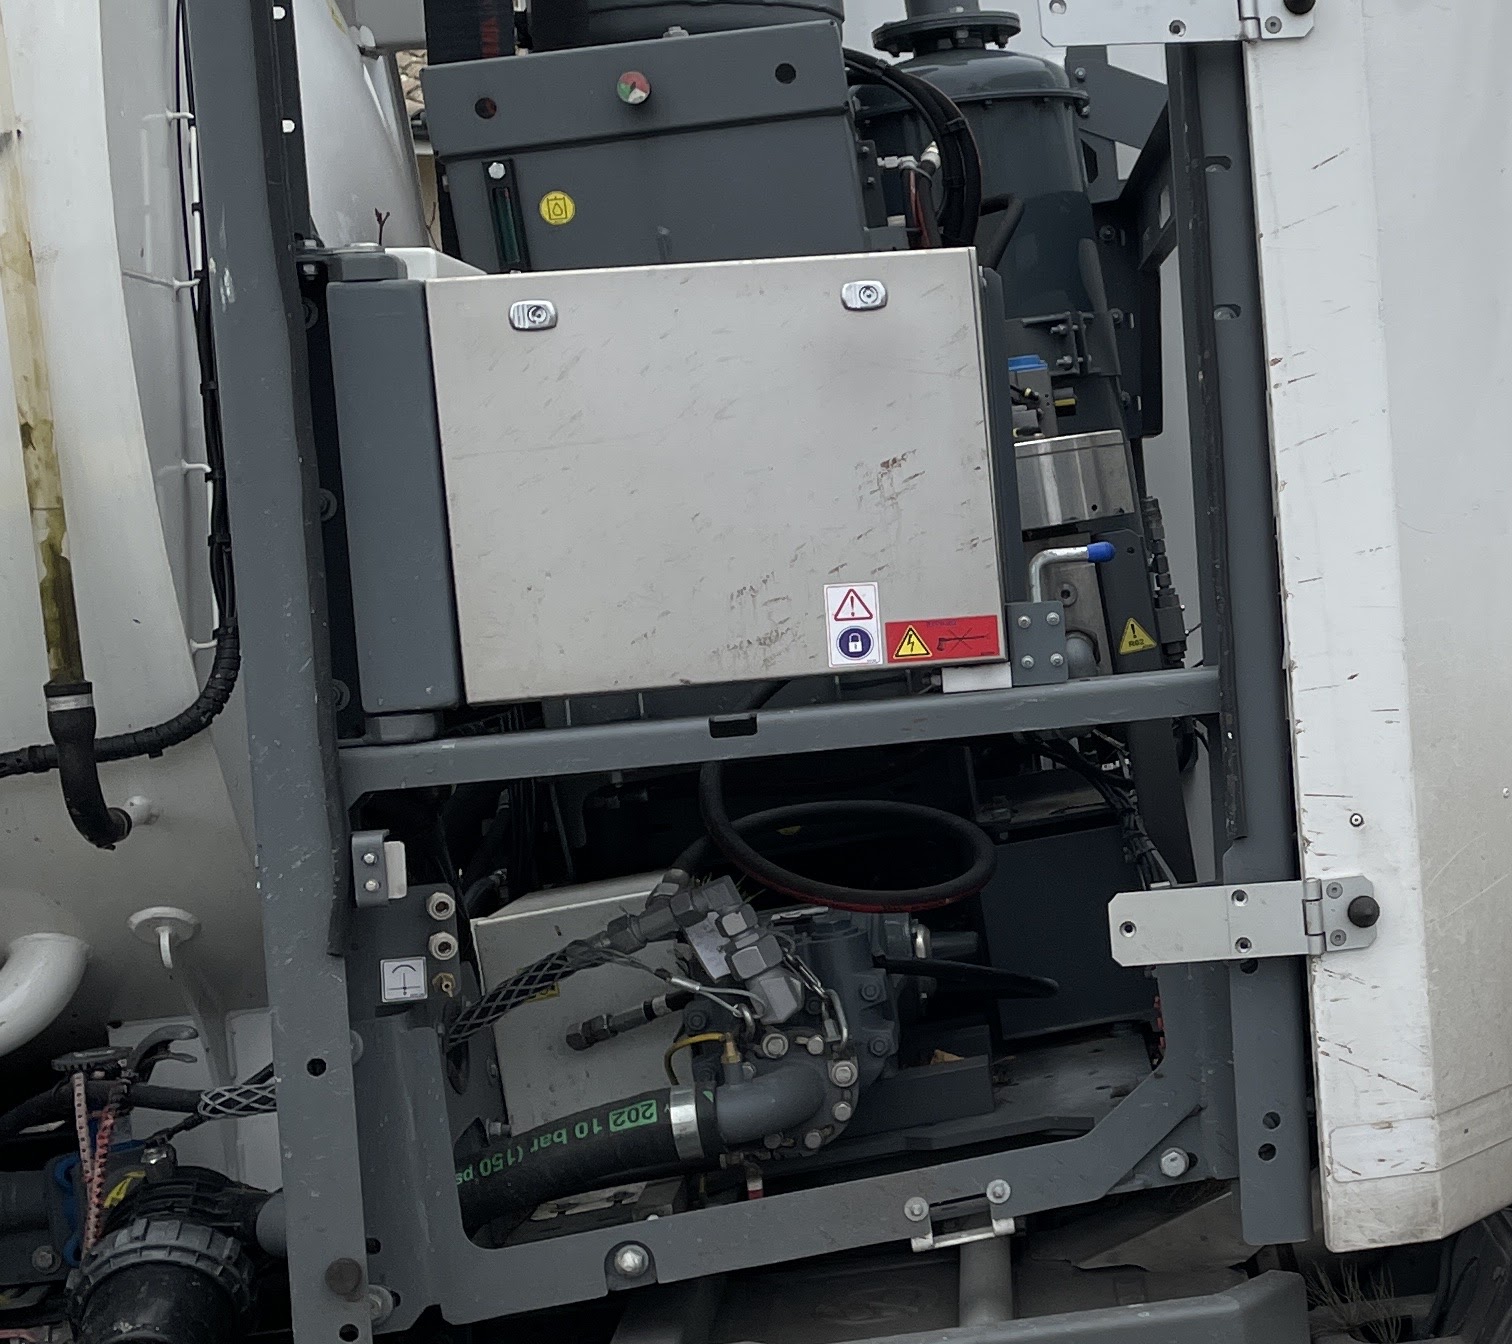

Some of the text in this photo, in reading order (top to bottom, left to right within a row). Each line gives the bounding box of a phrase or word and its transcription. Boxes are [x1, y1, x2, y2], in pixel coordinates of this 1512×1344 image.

[613, 1103, 654, 1128] 202
[530, 1128, 568, 1153] bar
[575, 1118, 602, 1139] 10
[479, 1146, 524, 1177] (150
[455, 1167, 473, 1186] ps
